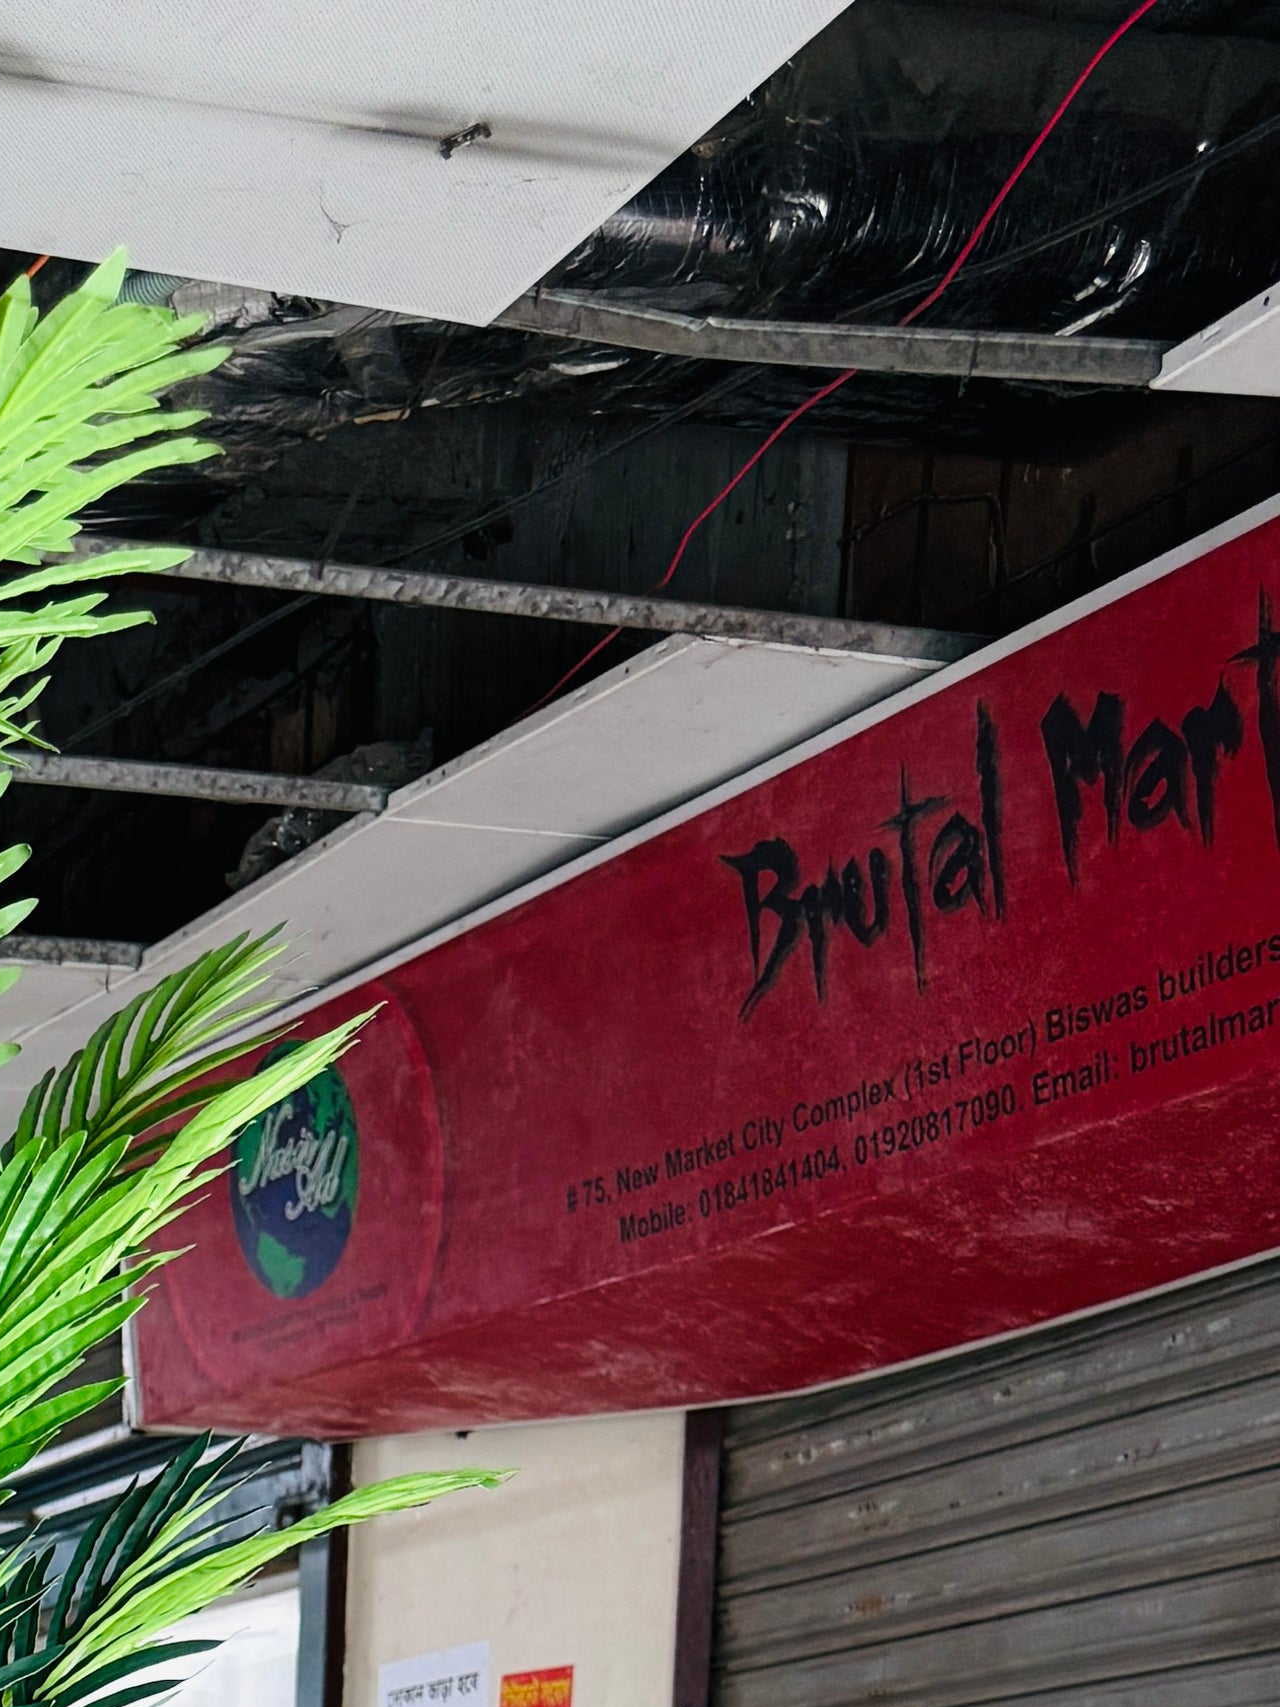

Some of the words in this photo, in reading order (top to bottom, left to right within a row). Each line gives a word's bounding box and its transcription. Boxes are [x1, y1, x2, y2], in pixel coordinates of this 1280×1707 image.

[717, 696, 1007, 1024] Brutal
[615, 1162, 659, 1197] New
[663, 1131, 737, 1180] Market
[741, 1115, 786, 1150] City
[792, 1075, 897, 1134] Complex
[903, 1052, 951, 1101] (1st
[958, 1018, 1038, 1077] Floor)
[1044, 982, 1149, 1046] Biswas
[618, 1200, 695, 1244] Mobile:
[1031, 1051, 1120, 1107] Email:
